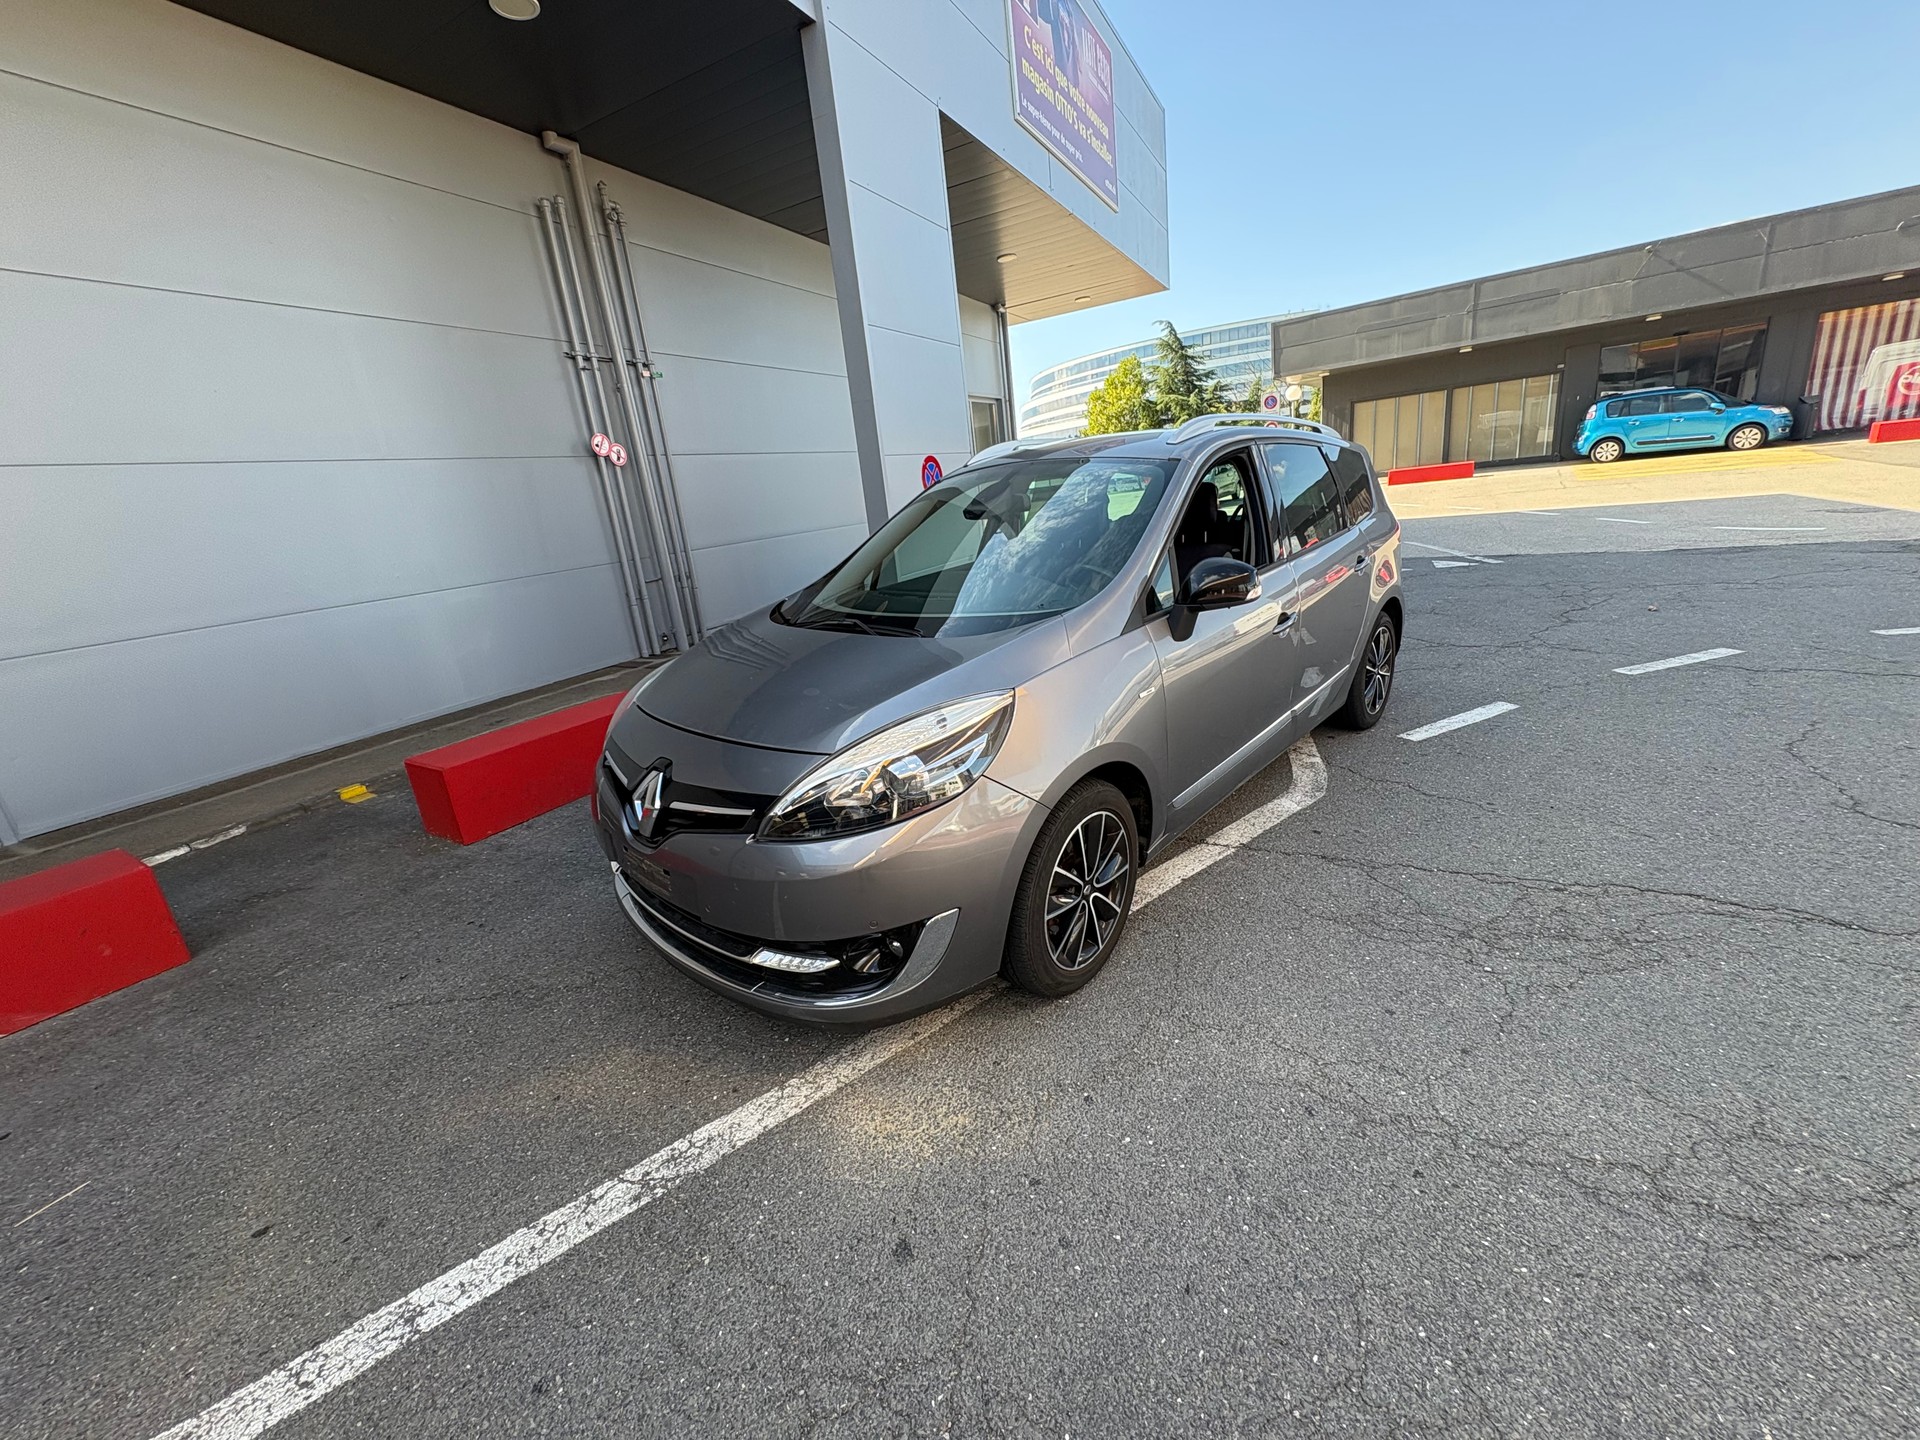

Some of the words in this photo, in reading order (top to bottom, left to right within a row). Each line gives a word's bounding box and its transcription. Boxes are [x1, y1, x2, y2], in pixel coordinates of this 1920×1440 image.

[1021, 56, 1054, 106] magasin
[1055, 91, 1078, 130] OTTO'S
[1078, 120, 1087, 139] va
[1044, 49, 1054, 75] ici
[1055, 64, 1068, 91] que
[1068, 81, 1085, 112] votre
[1086, 102, 1109, 140] nouveau
